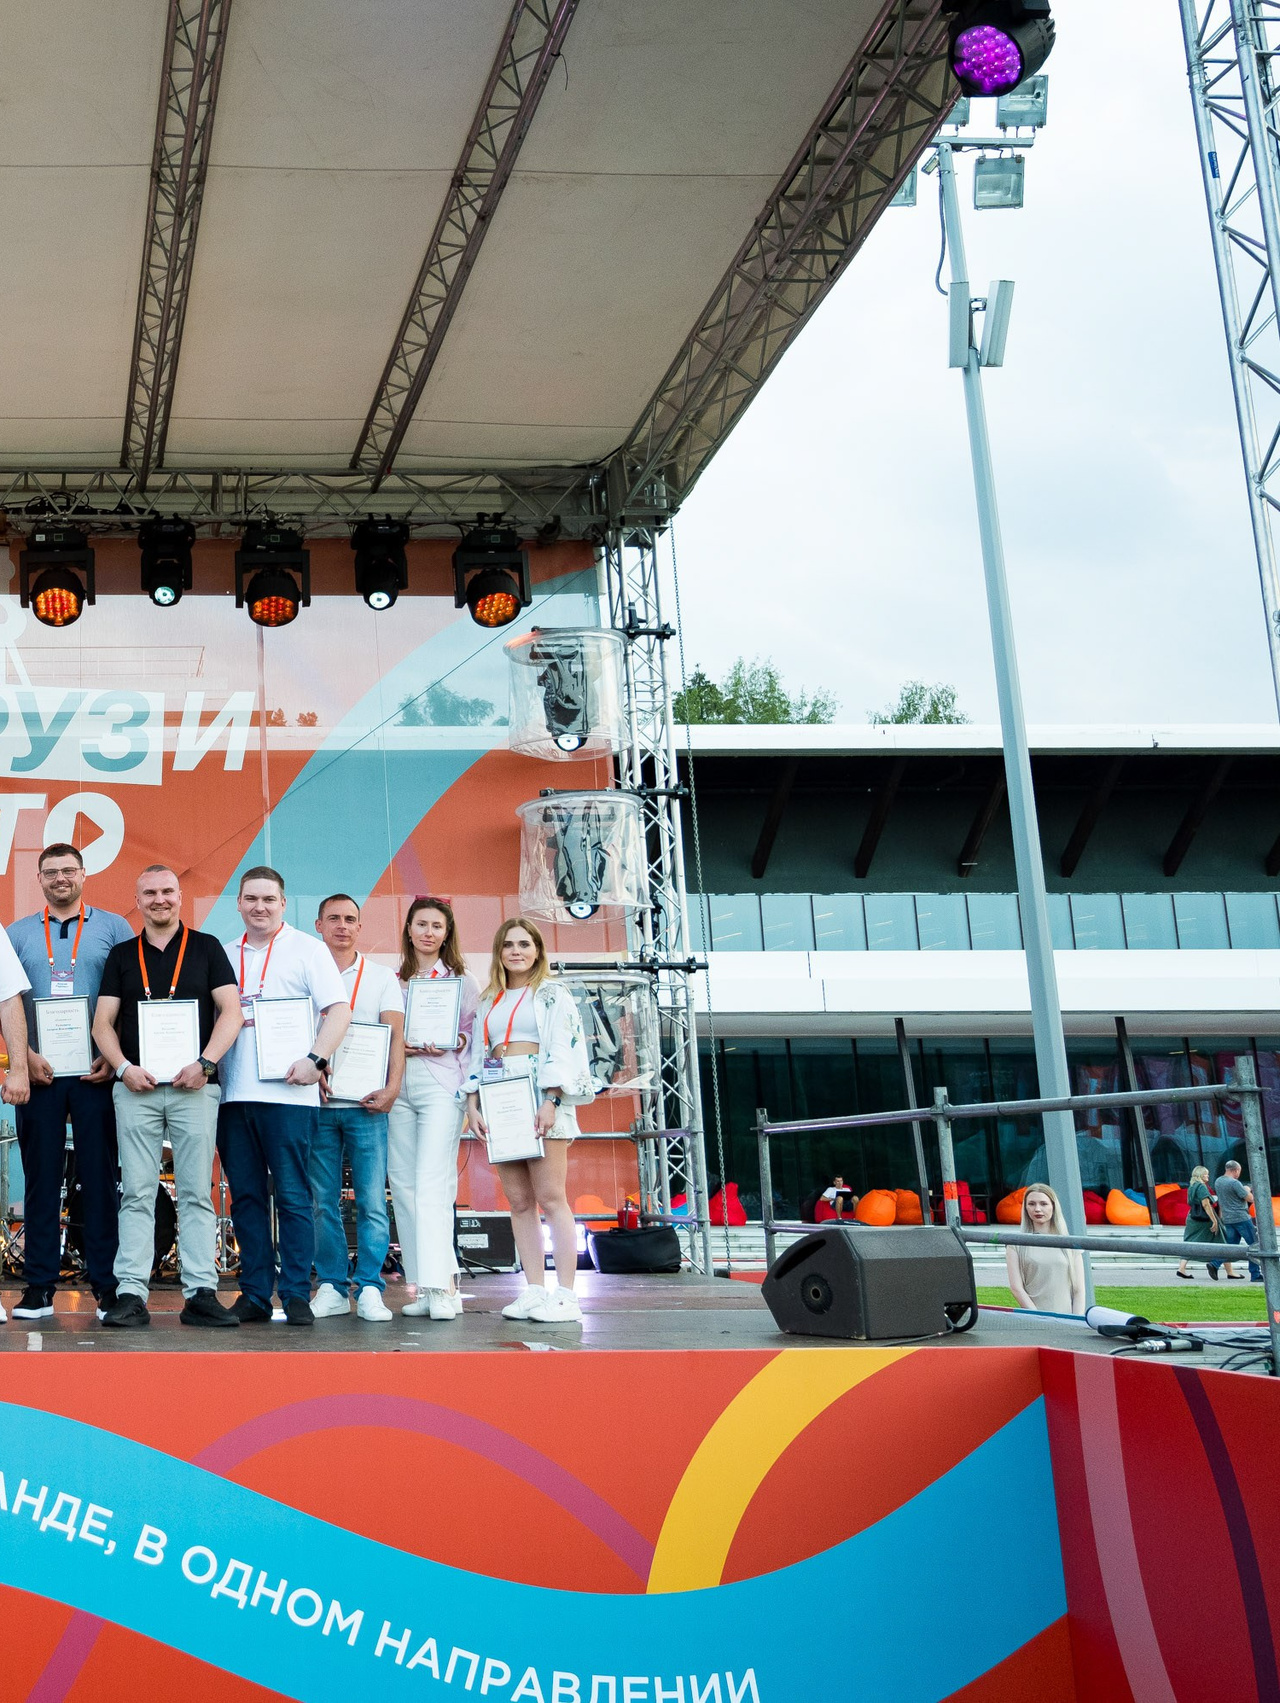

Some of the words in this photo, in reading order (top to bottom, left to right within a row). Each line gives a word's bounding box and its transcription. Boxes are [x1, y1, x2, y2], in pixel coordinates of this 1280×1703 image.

[133, 1524, 168, 1565] В
[181, 1545, 364, 1646] ОДНОМ
[374, 1620, 761, 1703] НАПРАВЛЕНИИ
